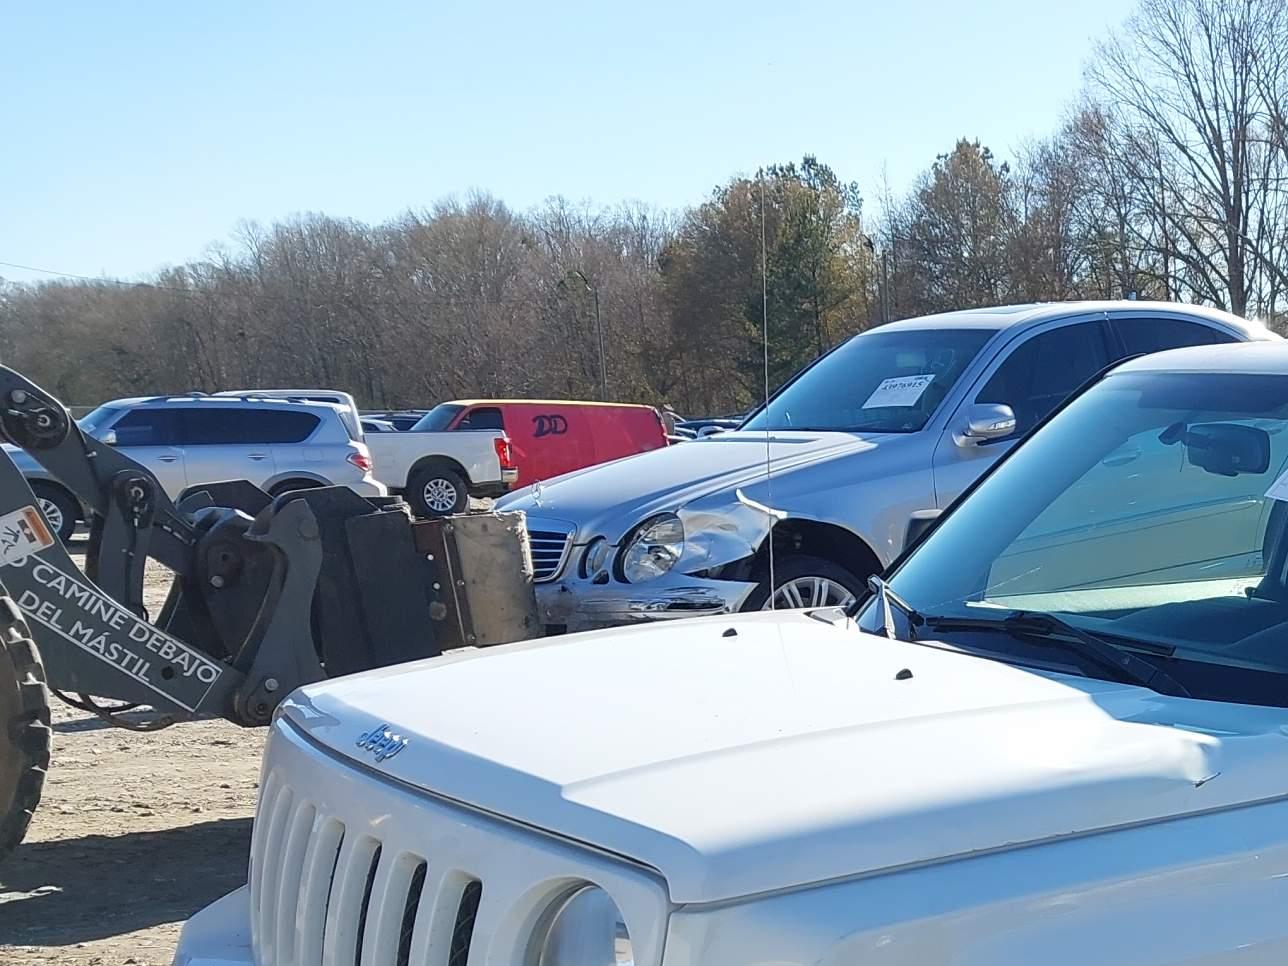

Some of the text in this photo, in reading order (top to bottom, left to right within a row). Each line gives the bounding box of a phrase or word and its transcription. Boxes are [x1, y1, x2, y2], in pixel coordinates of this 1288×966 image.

[18, 590, 152, 682] DEL MÁSTIL
[32, 564, 218, 683] CAMINE DEBAJO
[355, 723, 409, 763] Jeep
